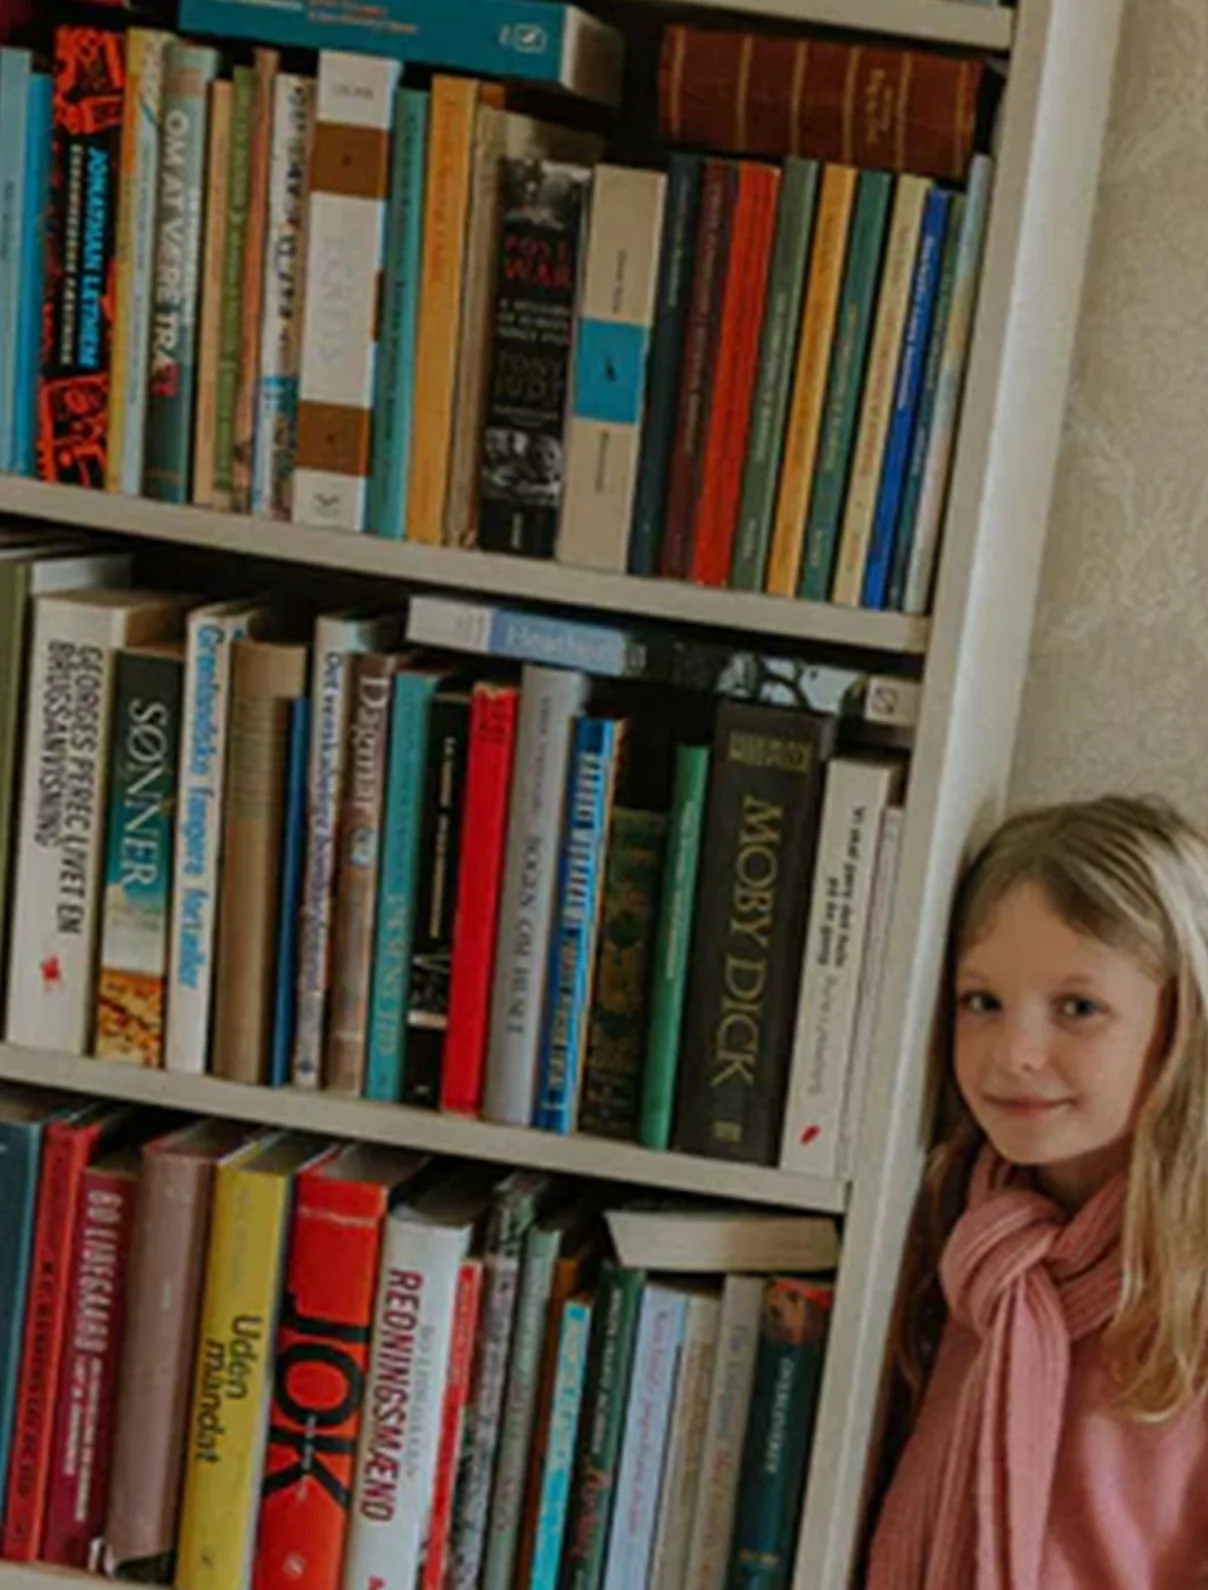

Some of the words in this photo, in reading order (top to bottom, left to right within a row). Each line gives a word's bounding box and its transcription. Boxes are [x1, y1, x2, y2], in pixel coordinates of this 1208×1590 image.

[162, 109, 189, 165] OM
[82, 147, 106, 268] JONATHAN
[160, 173, 187, 207] AT
[157, 216, 185, 303] VÆRE
[504, 233, 569, 260] POST
[504, 257, 572, 289] WAR
[78, 275, 99, 367] LETHEM
[34, 641, 73, 848] BRUGSANVISNING
[71, 645, 103, 751] GEORGES
[190, 623, 224, 775] Grønlandske
[350, 672, 389, 813] Dagmar
[64, 755, 94, 830] PEREC
[117, 698, 170, 889] SØNNER
[179, 786, 213, 878] fangere
[57, 834, 88, 897] LIVET
[732, 793, 784, 950] MOBY
[56, 905, 82, 934] EN
[177, 888, 207, 989] fortæller
[710, 953, 766, 1088] DICK
[85, 1188, 122, 1221] BO
[71, 1225, 120, 1352] LIDEGAARD
[194, 1337, 233, 1465] mandat
[226, 1314, 262, 1401] Uden
[260, 1290, 373, 1513] JOK
[360, 1269, 422, 1523] REDNINGSMÆND
